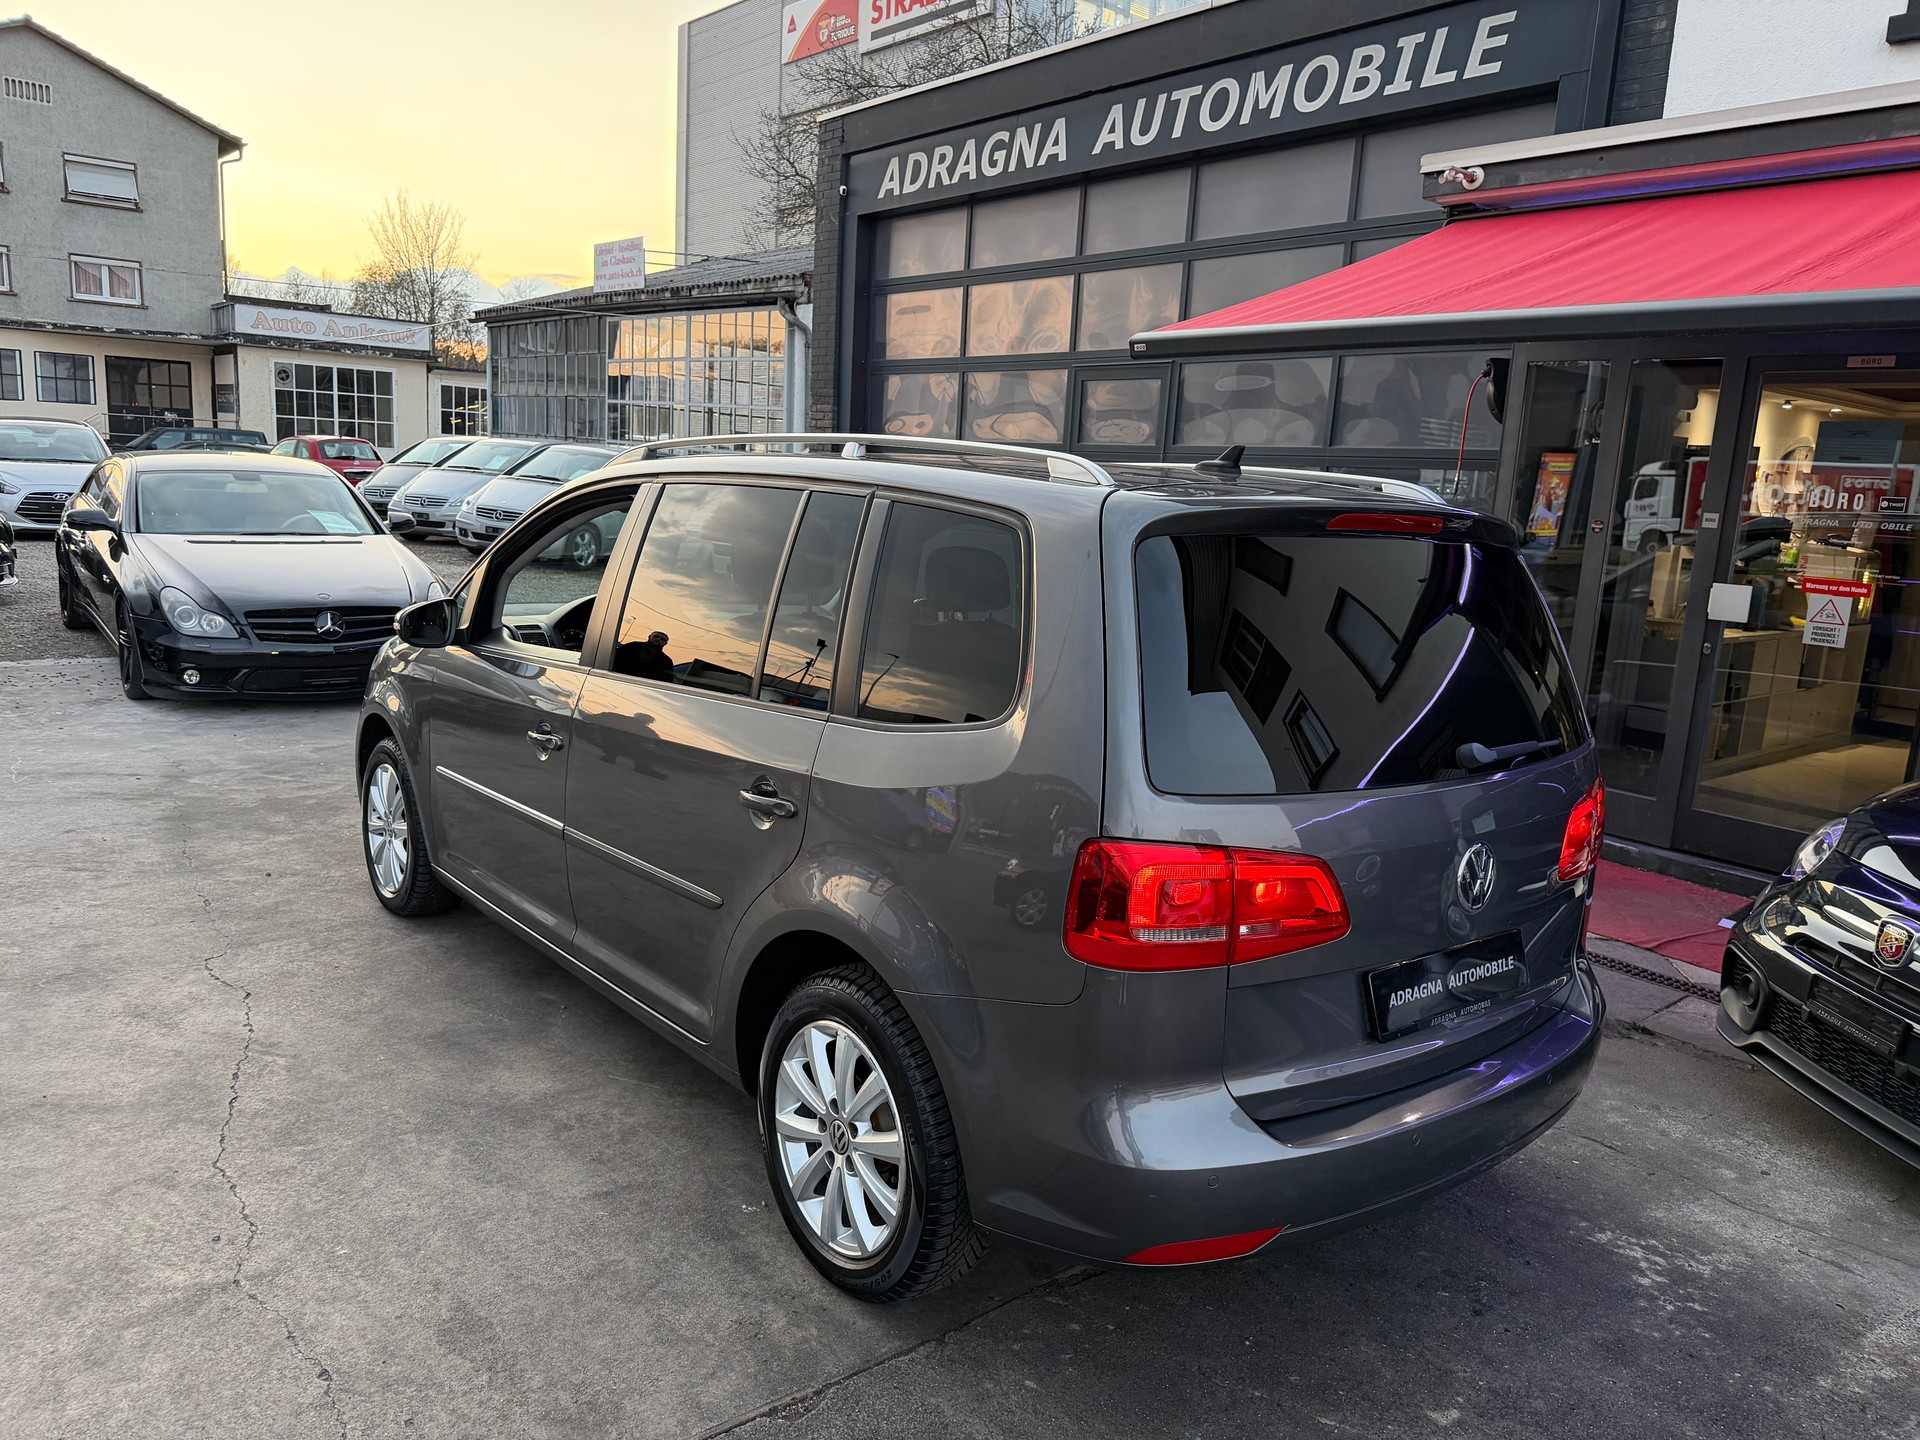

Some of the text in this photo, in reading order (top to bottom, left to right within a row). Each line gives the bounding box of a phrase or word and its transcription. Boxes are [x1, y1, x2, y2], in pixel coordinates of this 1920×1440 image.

[877, 10, 1519, 199] ADRAGNA AUTOMOBILE
[251, 310, 416, 345] Auto Ankauf
[1860, 356, 1883, 366] BÜRO
[1808, 488, 1865, 511] BÜRO
[1805, 582, 1829, 591] Warnung
[1851, 586, 1868, 594] Hunde
[1811, 631, 1836, 639] PRUDENCE
[1812, 625, 1837, 633] VORSICHT
[1810, 637, 1835, 645] PRUDENZA
[1389, 955, 1515, 1008] ADRAGNA AUTOMOBILE
[1430, 999, 1492, 1026] ADRAGNA AUTOMOBILE
[1816, 1009, 1842, 1027] ADRAGNA
